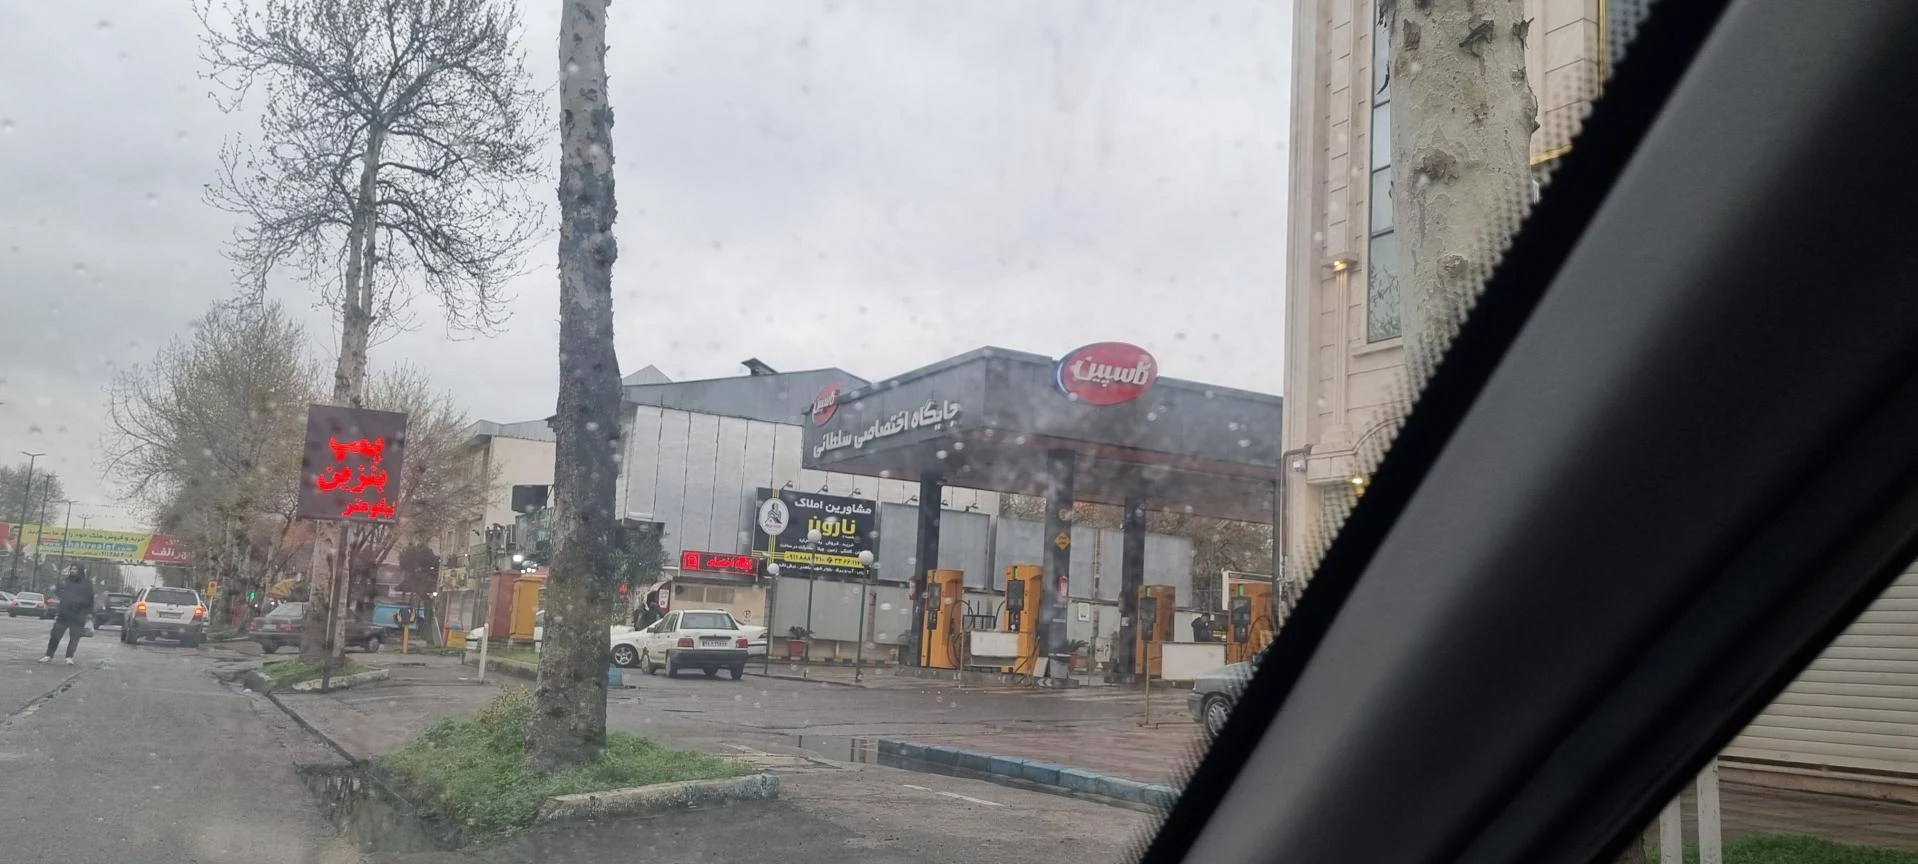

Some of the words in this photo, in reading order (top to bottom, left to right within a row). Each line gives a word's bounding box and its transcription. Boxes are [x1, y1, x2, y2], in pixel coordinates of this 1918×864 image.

[1068, 355, 1152, 388] کاسپین
[911, 399, 961, 430] جایگاه
[813, 429, 851, 458] سلطانی
[854, 410, 909, 449] اختصاصی
[316, 465, 388, 494] بنزین
[794, 497, 823, 510] املاک
[825, 502, 872, 515] مشاورین
[808, 515, 856, 537] نارون
